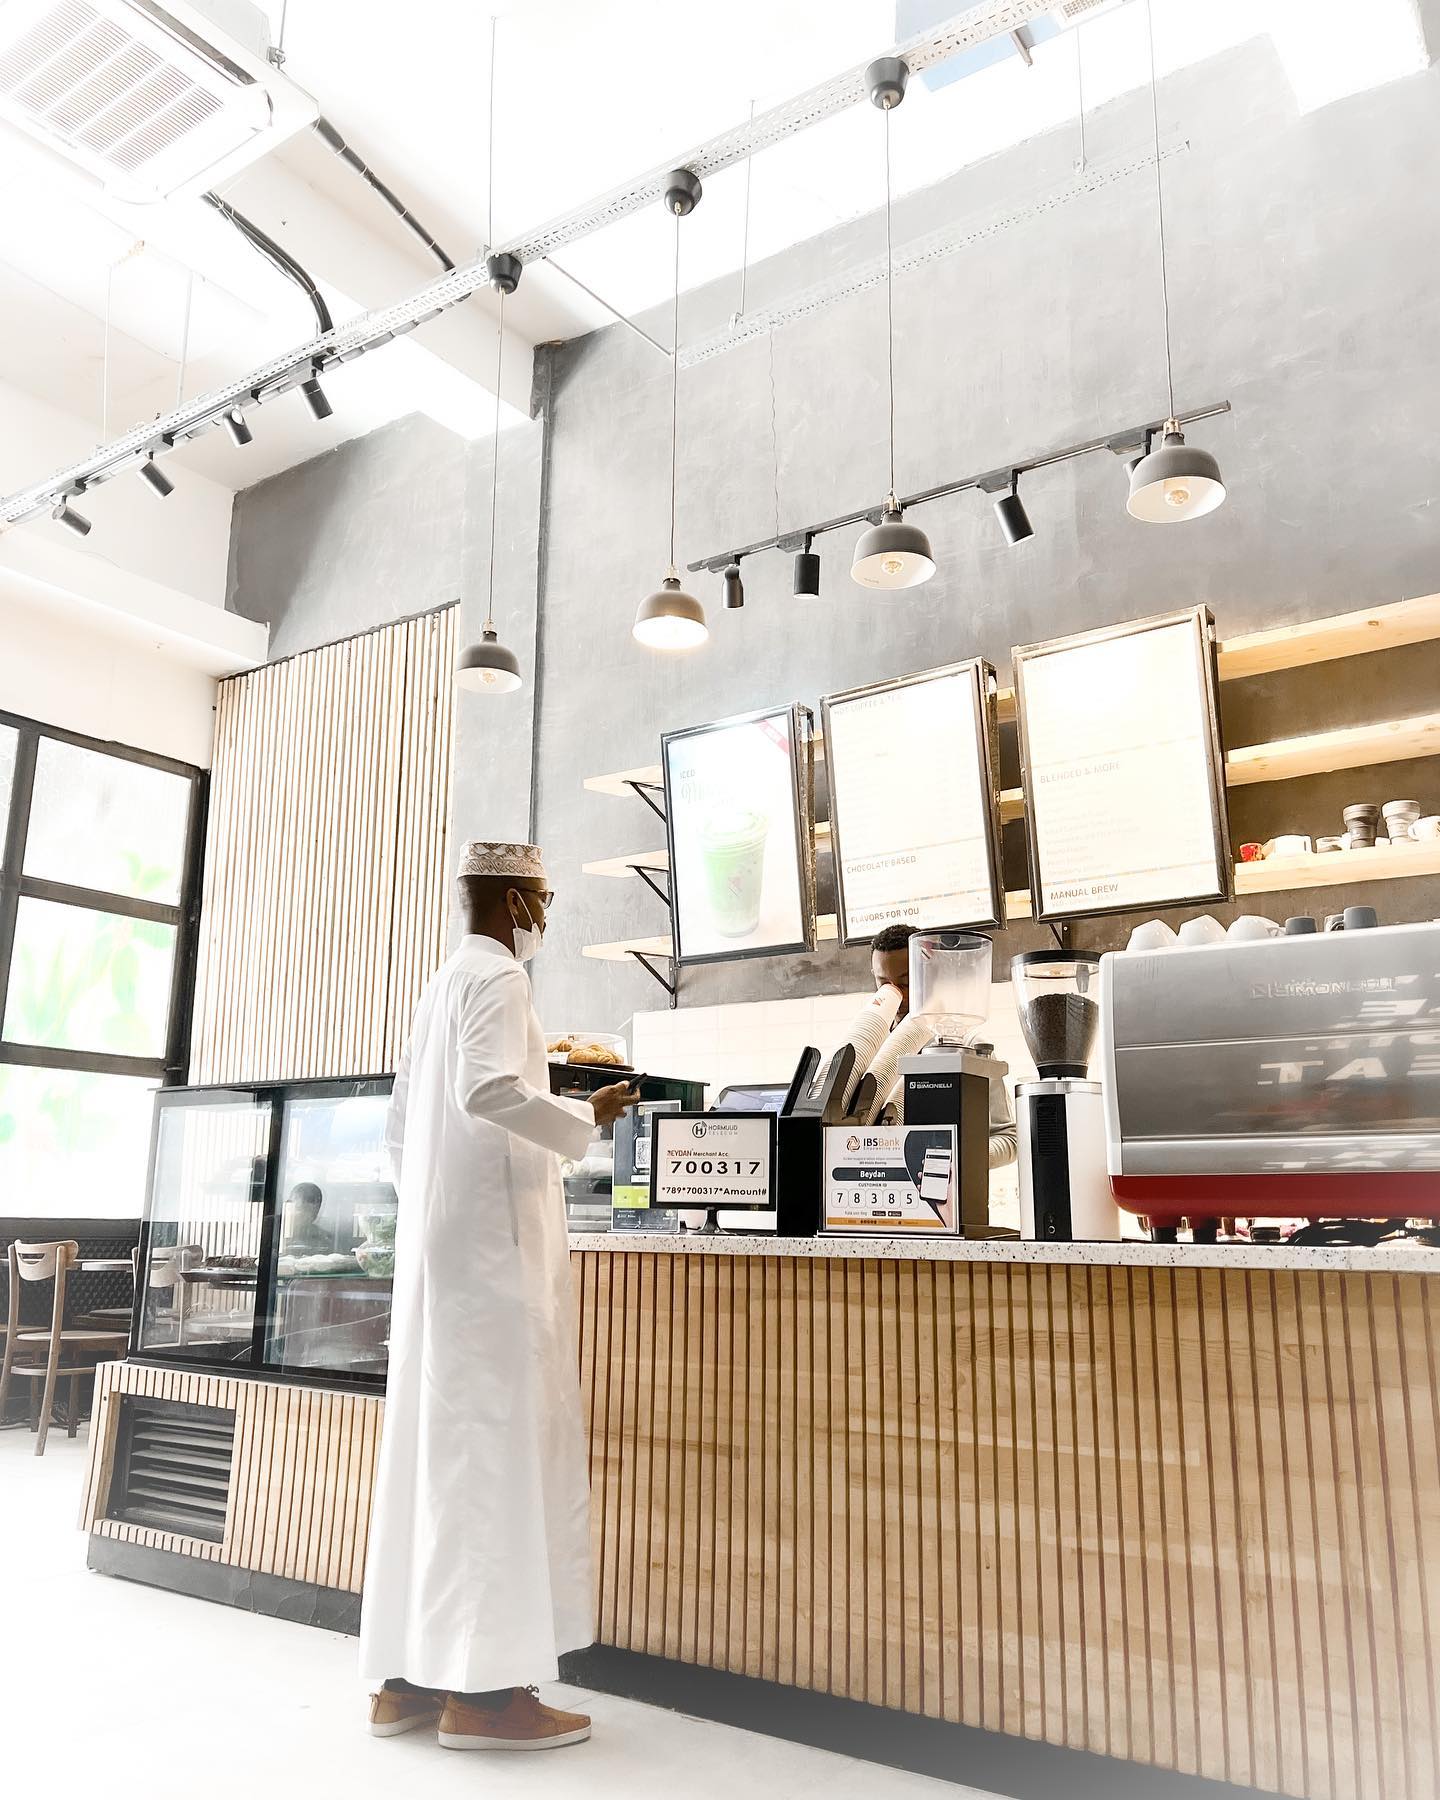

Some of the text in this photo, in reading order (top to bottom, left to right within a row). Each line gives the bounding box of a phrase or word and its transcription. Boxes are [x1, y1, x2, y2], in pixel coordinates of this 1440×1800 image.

[1040, 768, 1082, 784] BLENDED
[1094, 761, 1121, 774] MORE
[847, 855, 917, 874] CHOCOLATE BASED
[1050, 883, 1119, 900] MANUAL BREW
[850, 907, 919, 924] FLAVORS FOR YOU
[671, 1160, 761, 1175] 700317
[860, 1168, 886, 1180] Beydan
